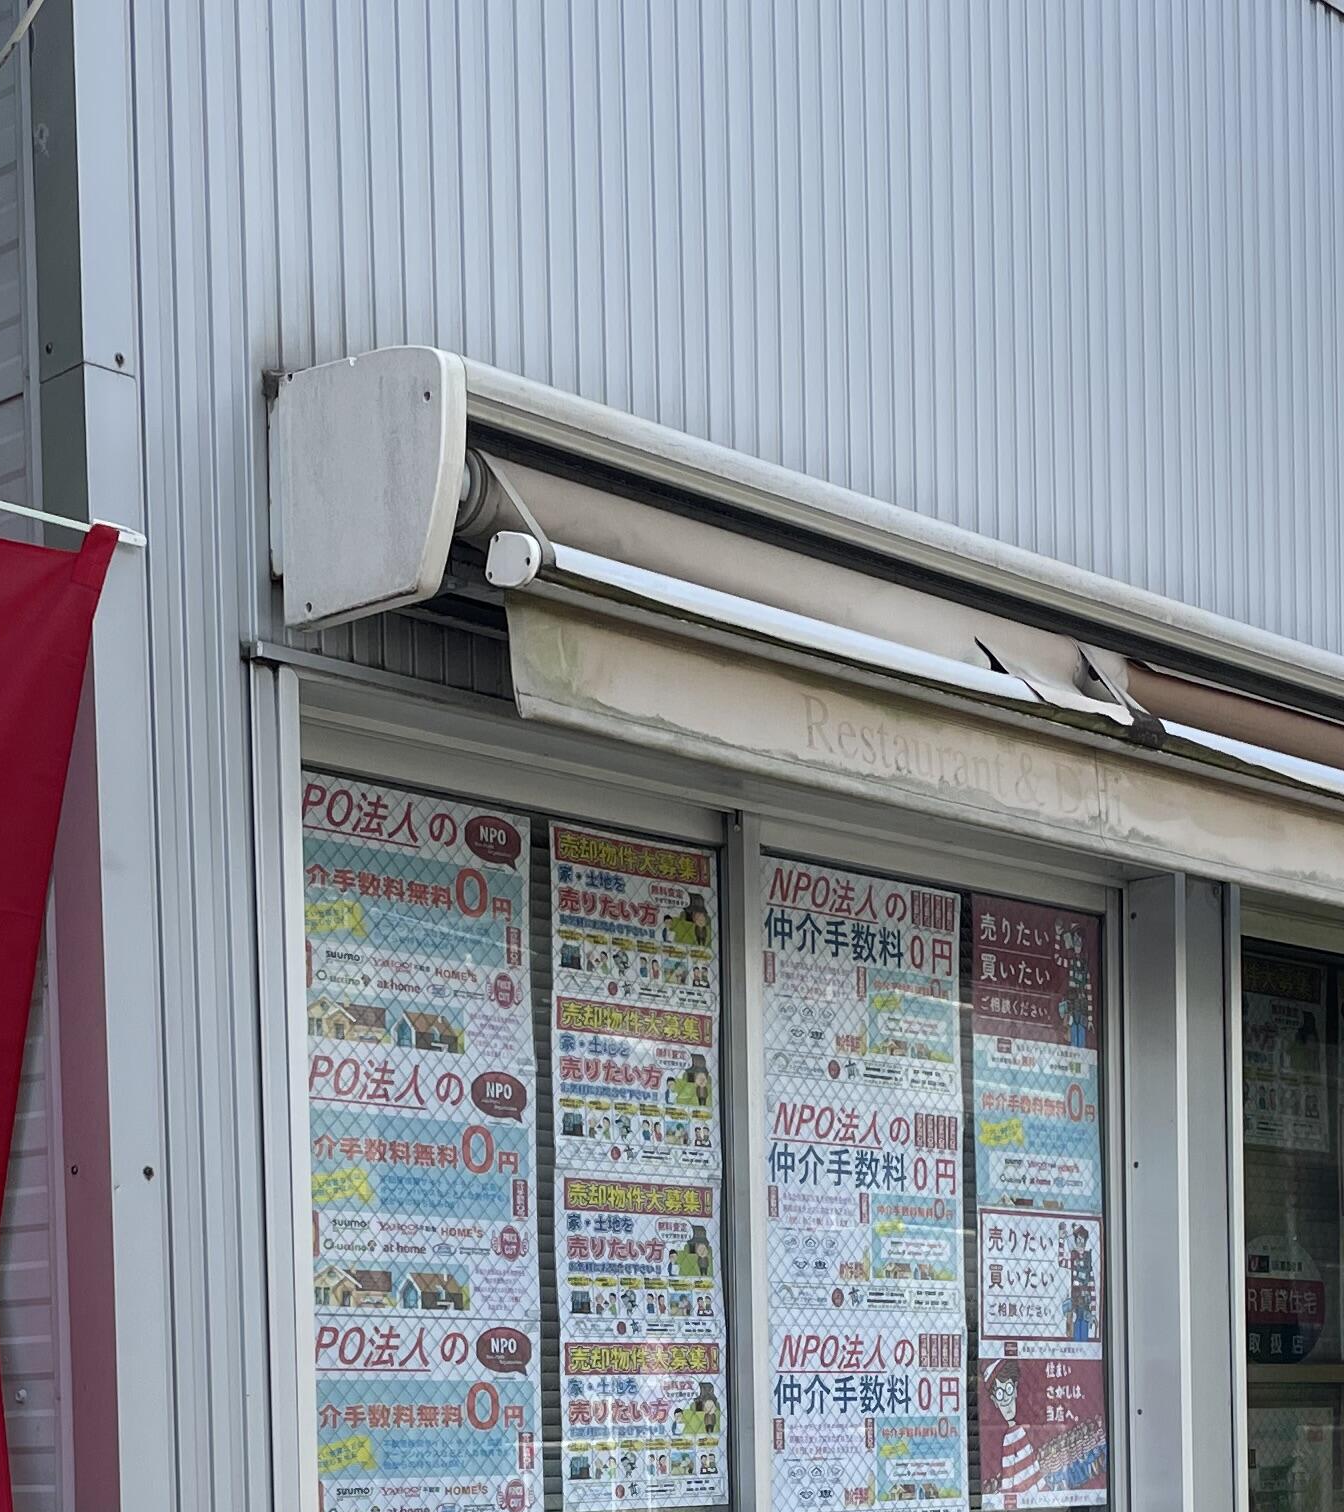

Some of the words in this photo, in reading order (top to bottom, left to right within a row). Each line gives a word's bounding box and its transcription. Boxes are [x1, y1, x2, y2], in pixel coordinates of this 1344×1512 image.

[803, 693, 1004, 793] Restaurant
[1014, 752, 1043, 807] &
[479, 825, 507, 844] NPO
[559, 887, 660, 927] 売りたい方
[769, 867, 907, 922] NPO法人の
[980, 913, 1050, 946] 売りたい
[980, 953, 1051, 985] 買いたい
[560, 1056, 664, 1090] 売りたい方
[485, 1082, 513, 1099] NPO
[772, 1102, 911, 1146] NPO法人の
[568, 1182, 711, 1214] 売却物件大募集!
[567, 1235, 666, 1263] 売りたい方
[988, 1226, 1054, 1253] 売りたい
[988, 1264, 1055, 1289] 買いたい
[491, 1338, 518, 1354] NPO
[778, 1334, 915, 1370] NPO法人の
[568, 1399, 671, 1425] 売りたい方
[445, 1483, 488, 1496] HOME'S
